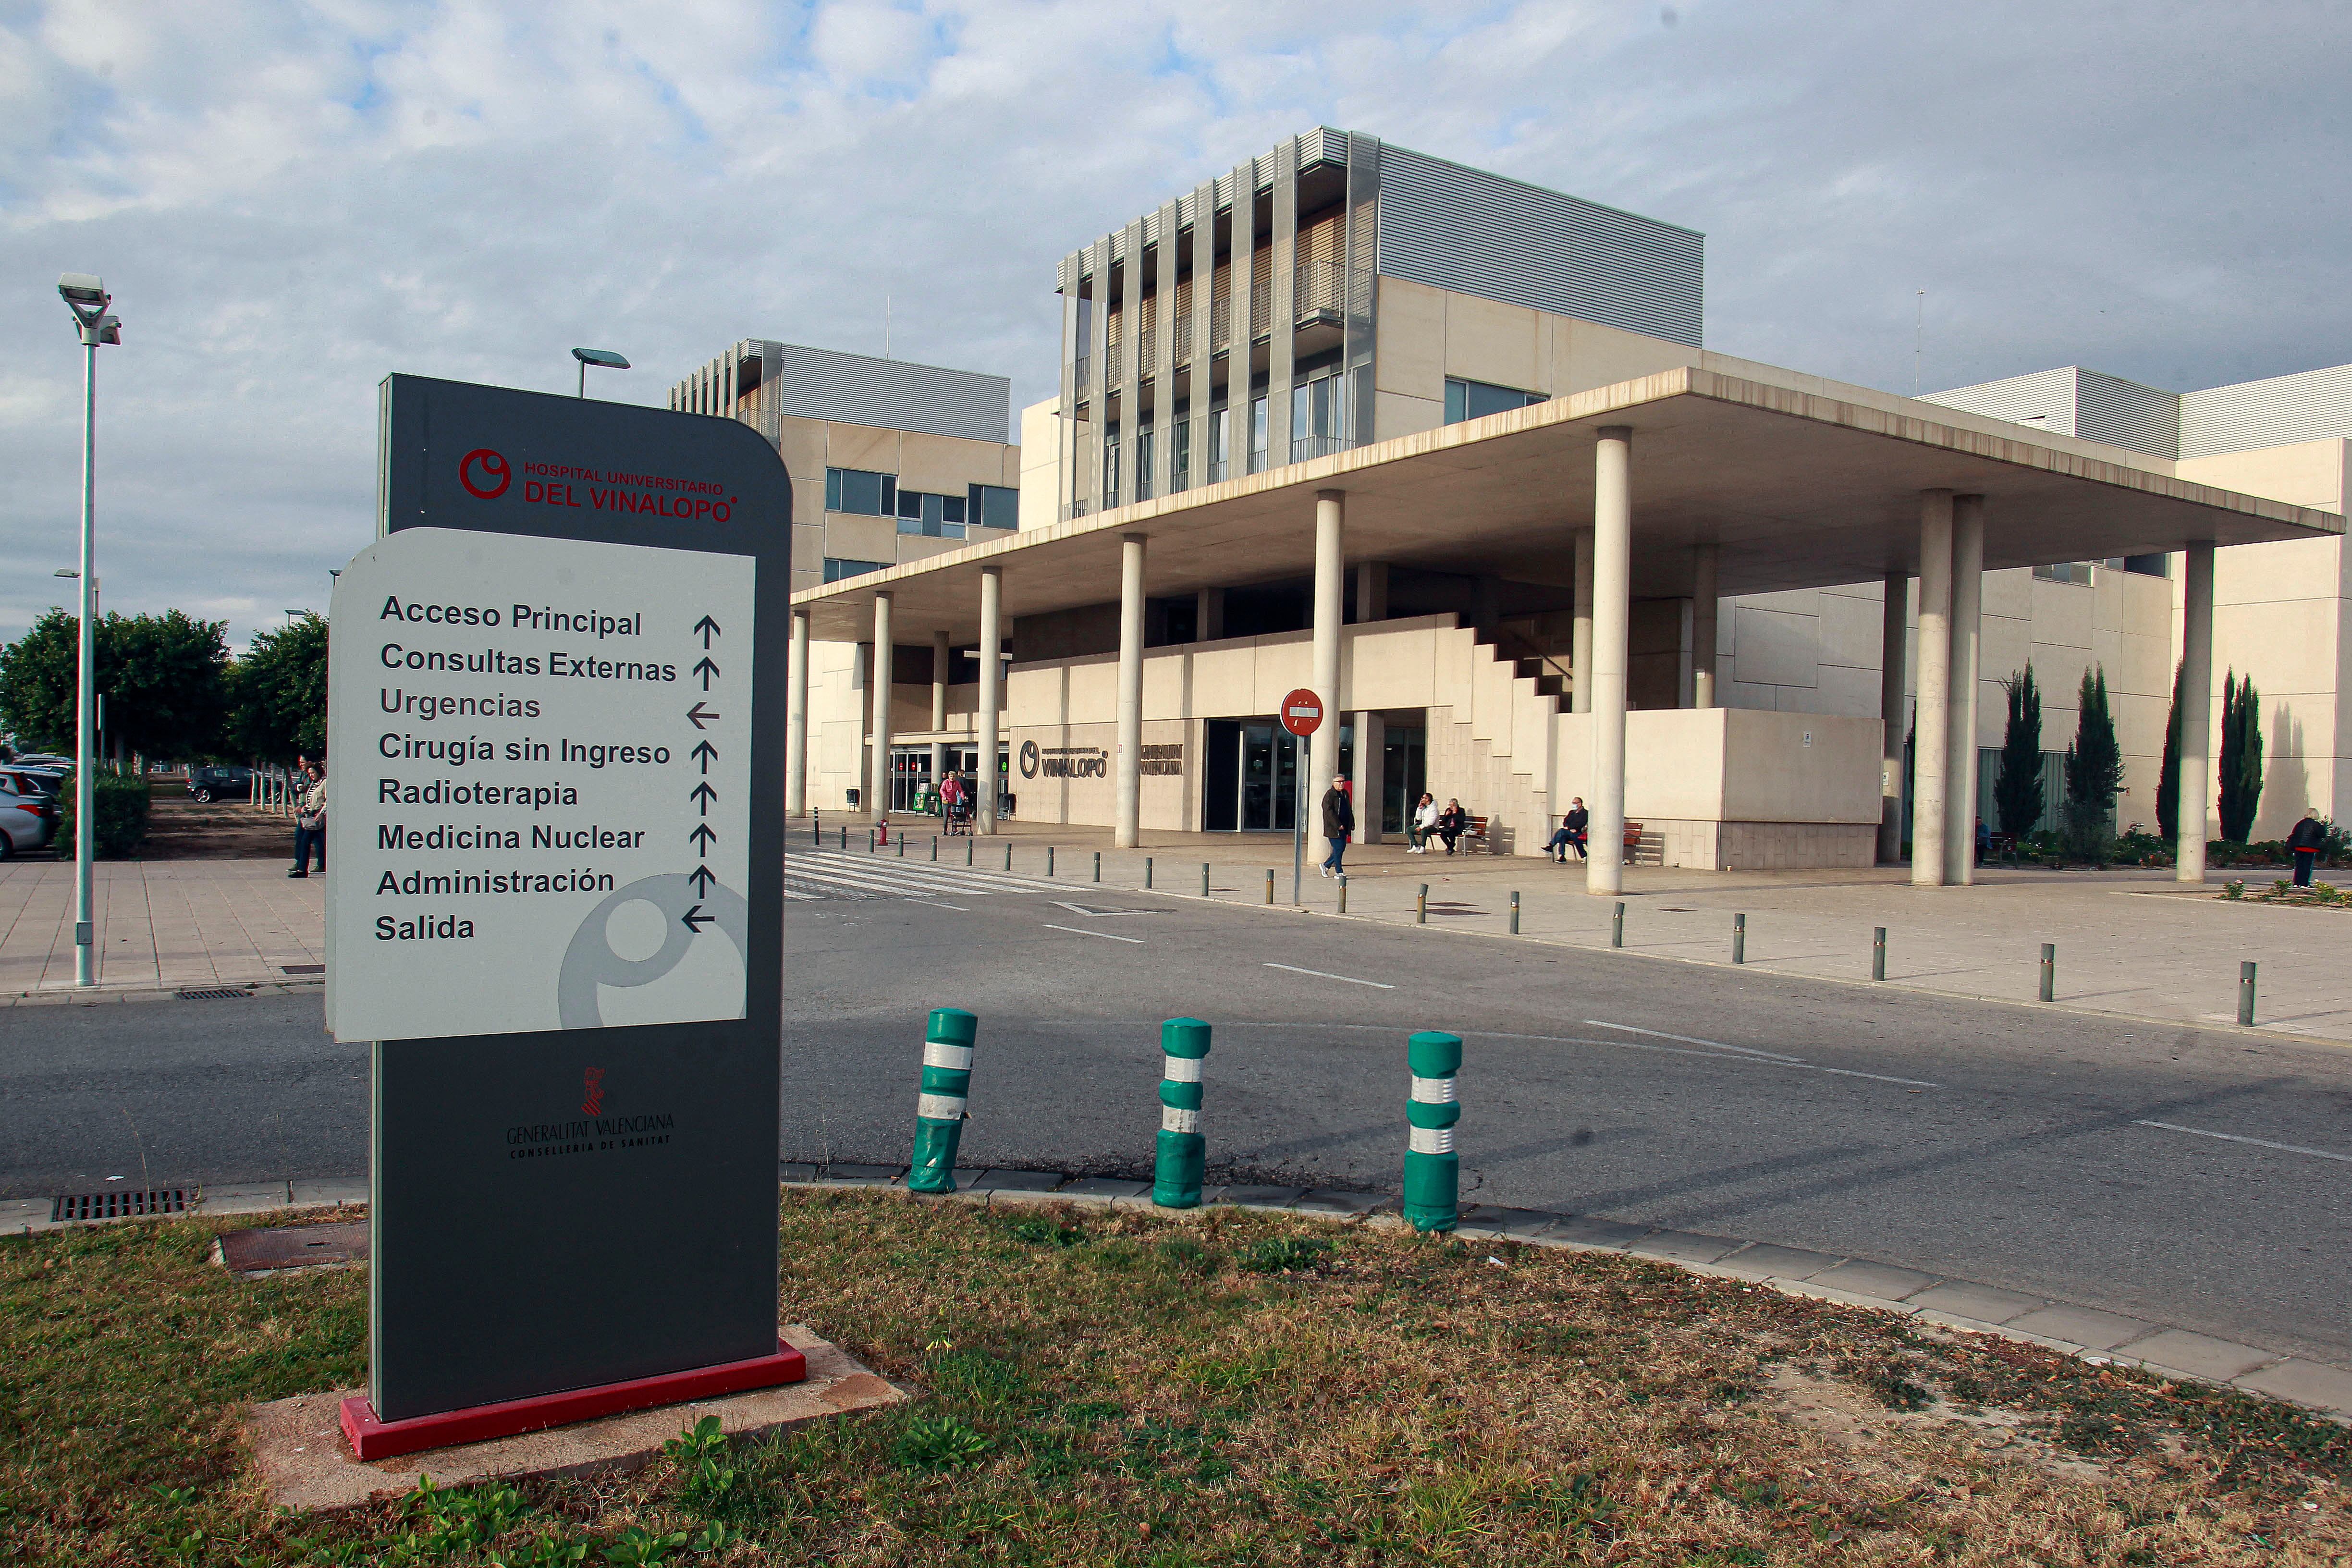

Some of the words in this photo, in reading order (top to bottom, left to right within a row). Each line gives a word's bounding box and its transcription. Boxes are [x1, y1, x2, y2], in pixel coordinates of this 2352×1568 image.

[525, 462, 602, 482] HOSPITAL
[608, 472, 723, 495] UNIVERSITARIO
[525, 481, 581, 507] DEL
[380, 596, 501, 627] Acceso
[513, 604, 640, 639] Principal
[381, 643, 540, 675] Consultas
[549, 652, 676, 682] Externas
[381, 688, 540, 721] Urgencias
[379, 733, 494, 766] Cirugía
[505, 737, 550, 761] sin
[562, 738, 670, 769] Ingreso
[379, 779, 577, 811] Radioterapia
[378, 824, 520, 849] Medicina
[532, 825, 646, 849] Nuclear
[376, 868, 613, 895] Administración
[375, 914, 474, 941] Salida
[507, 1121, 590, 1145] GENERALITAT
[596, 1114, 674, 1136] VALENCIANA
[511, 1143, 594, 1159] CONSELLERIA
[601, 1140, 615, 1150] DE
[622, 1135, 670, 1148] SANITAT
